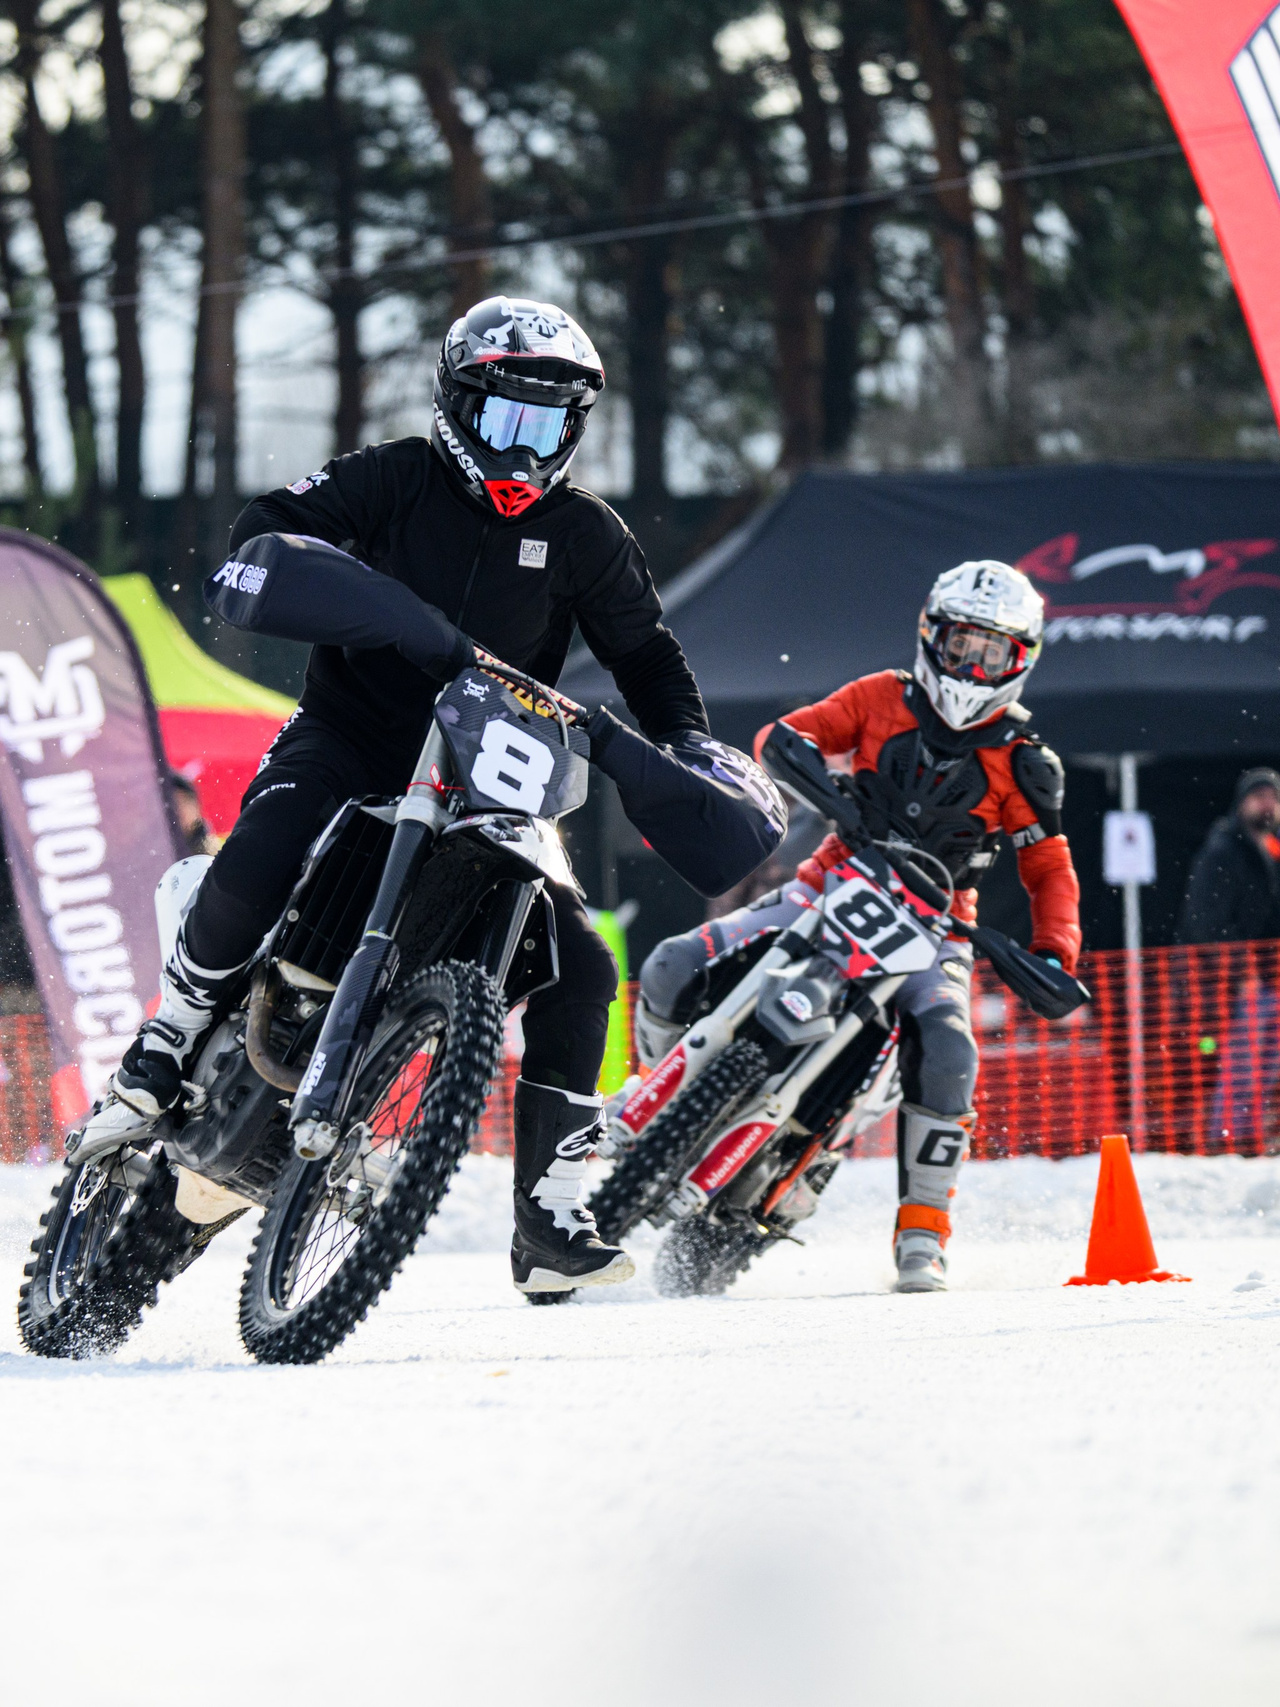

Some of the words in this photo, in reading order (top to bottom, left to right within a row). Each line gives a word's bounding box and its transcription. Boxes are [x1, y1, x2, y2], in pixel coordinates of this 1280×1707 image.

[522, 542, 545, 554] EA7
[471, 718, 556, 815] 8
[833, 889, 920, 959] 81
[303, 1051, 327, 1095] KTM
